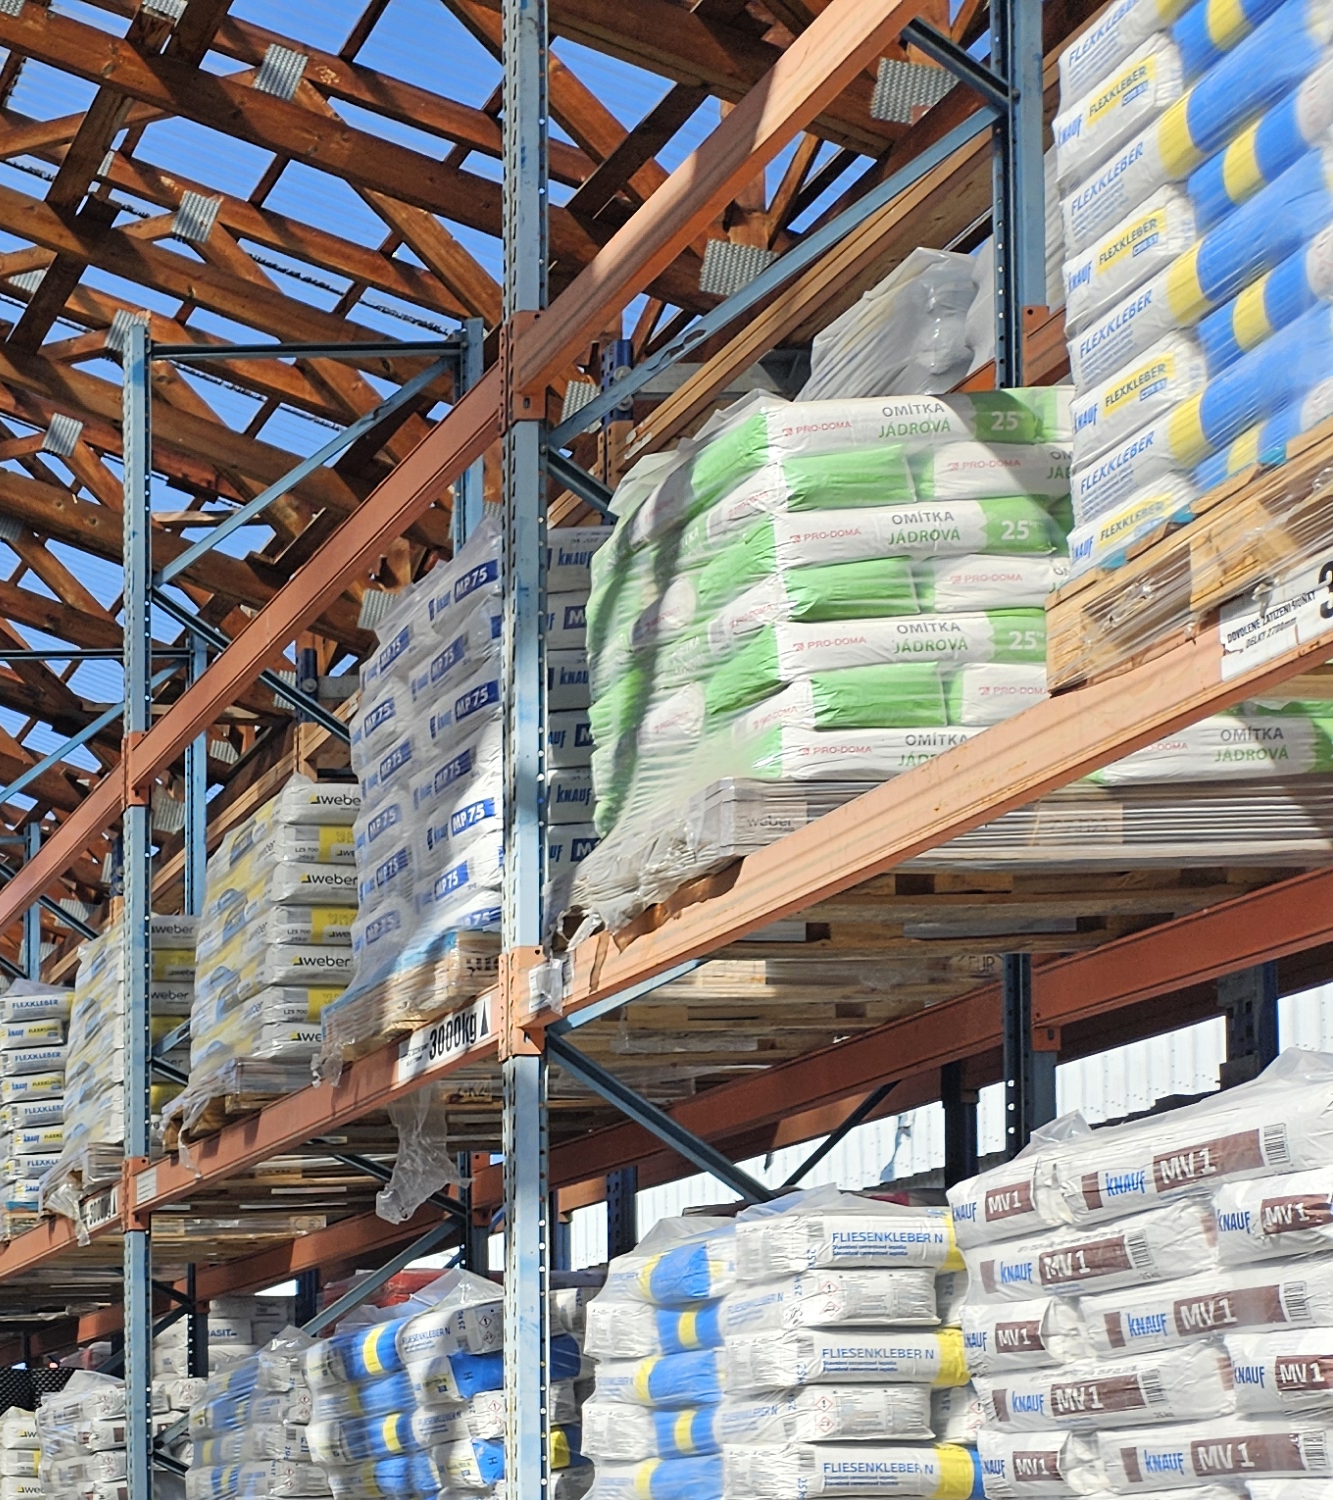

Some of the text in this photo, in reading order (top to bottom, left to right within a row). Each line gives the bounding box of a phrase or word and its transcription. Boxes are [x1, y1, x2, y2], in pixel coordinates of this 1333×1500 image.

[1089, 65, 1147, 117] FLEXKLEBER
[1071, 142, 1143, 216] FLEXKLEBER
[1099, 217, 1158, 266] FLEXKLEBER
[1081, 291, 1153, 357] FLEXKLEBER
[1105, 363, 1166, 408] FLEXKLEBER
[882, 403, 944, 417] OMÍTKA
[796, 421, 851, 434] PRO-DOMA
[879, 417, 951, 438] JÁDROVÁ
[962, 459, 1021, 468] PRO-DOMA
[1081, 431, 1154, 494] FLEXKLEBER
[892, 511, 954, 525] OMÍTKA
[804, 528, 861, 540] PRO-DOMA
[889, 528, 960, 545] JÁDROVÁ
[897, 622, 960, 634] OMÍTKA
[808, 637, 866, 650] PRO-DOMA
[894, 638, 968, 654] JÁDROVÁ
[1220, 727, 1283, 741] OMÍTKA
[814, 746, 872, 754] PRO-DOMA
[1215, 746, 1289, 762] JÁDROVÁ
[309, 873, 357, 886] weber
[302, 956, 350, 968] weber
[12, 1000, 58, 1009] FLEXKLEBER
[429, 1013, 477, 1060] 3000kg
[15, 1052, 61, 1061] FLEXKLEBER
[1105, 1148, 1216, 1196] KNAUF MV 1
[832, 1232, 943, 1244] FLIESENKLEBER N
[1001, 1251, 1090, 1284] KNAUF MV 1
[1127, 1298, 1237, 1337] KNAUF MV 1
[822, 1348, 934, 1359] FLIESENKLEBER N
[1234, 1363, 1324, 1389] KNAUF MV 1
[823, 1462, 934, 1475] FLIESENKLEBER N
